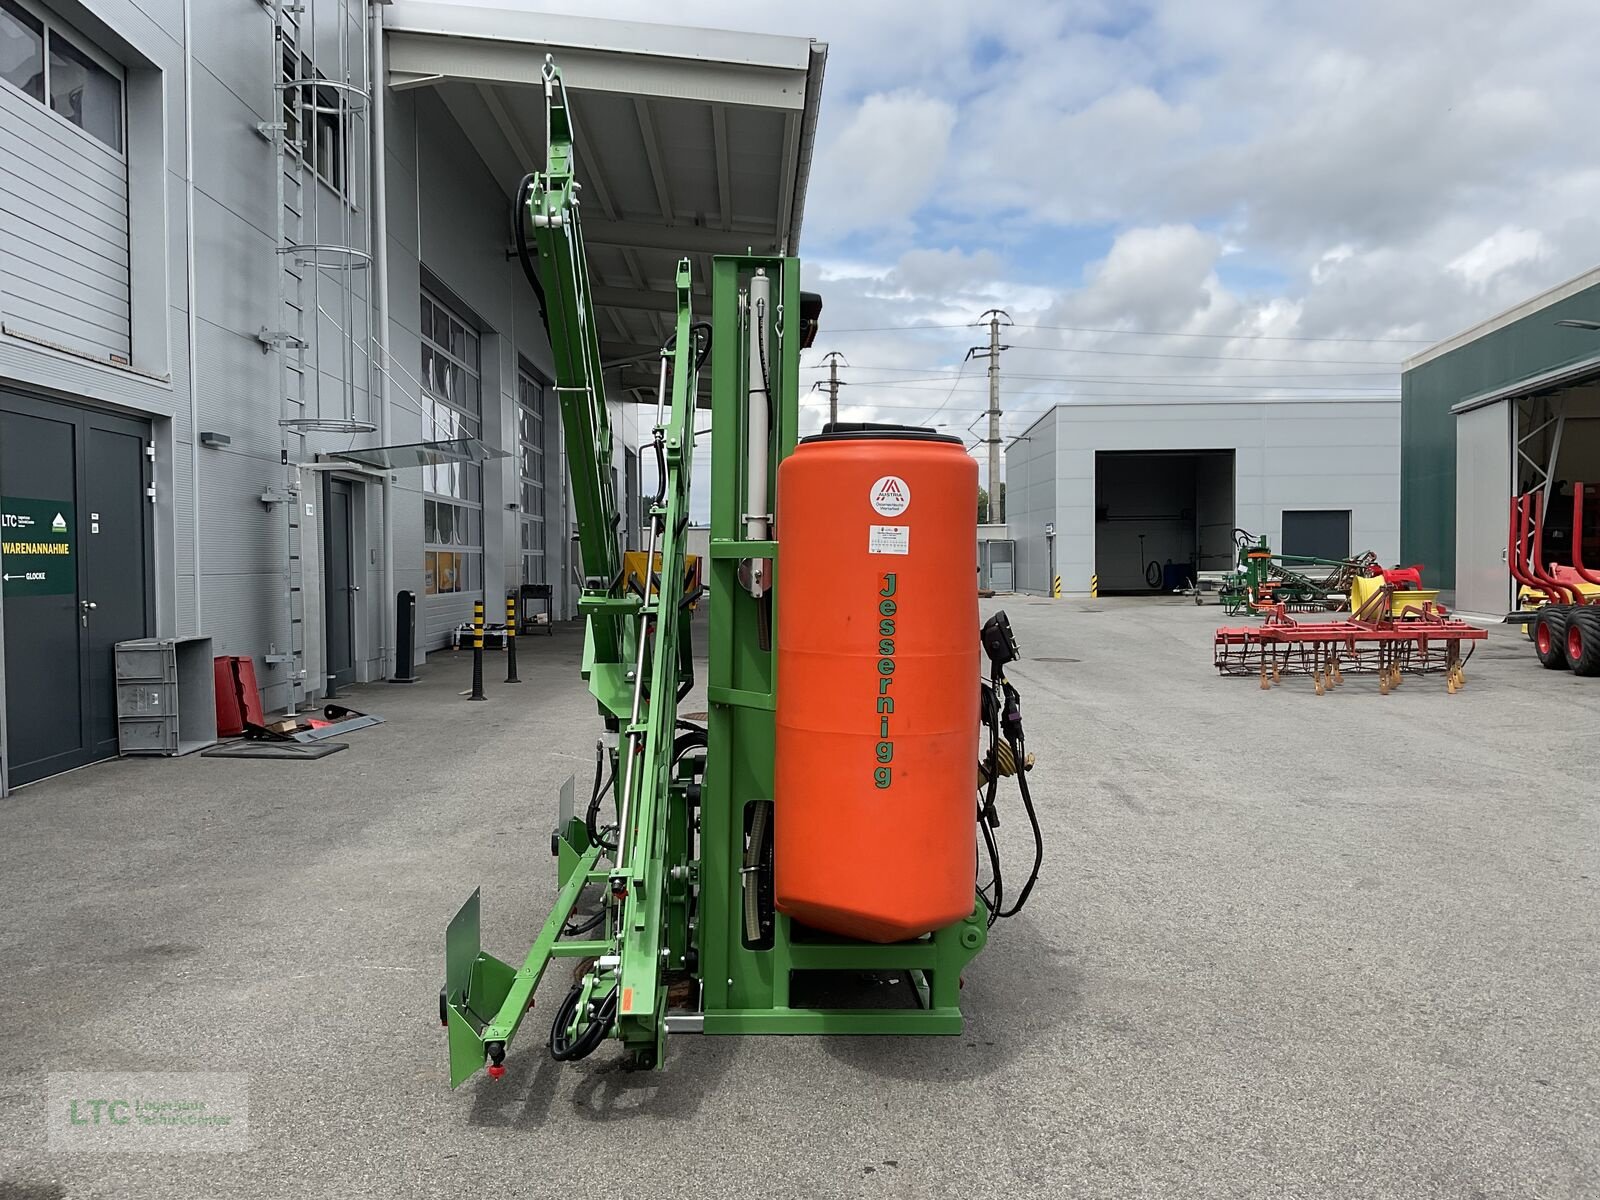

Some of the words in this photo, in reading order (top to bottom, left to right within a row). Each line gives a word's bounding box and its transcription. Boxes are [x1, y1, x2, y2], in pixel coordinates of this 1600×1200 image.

[1, 514, 17, 527] LTC
[2, 542, 69, 554] WARENANNAHME
[26, 572, 46, 580] GLOCKE
[874, 573, 897, 789] Jessernigg
